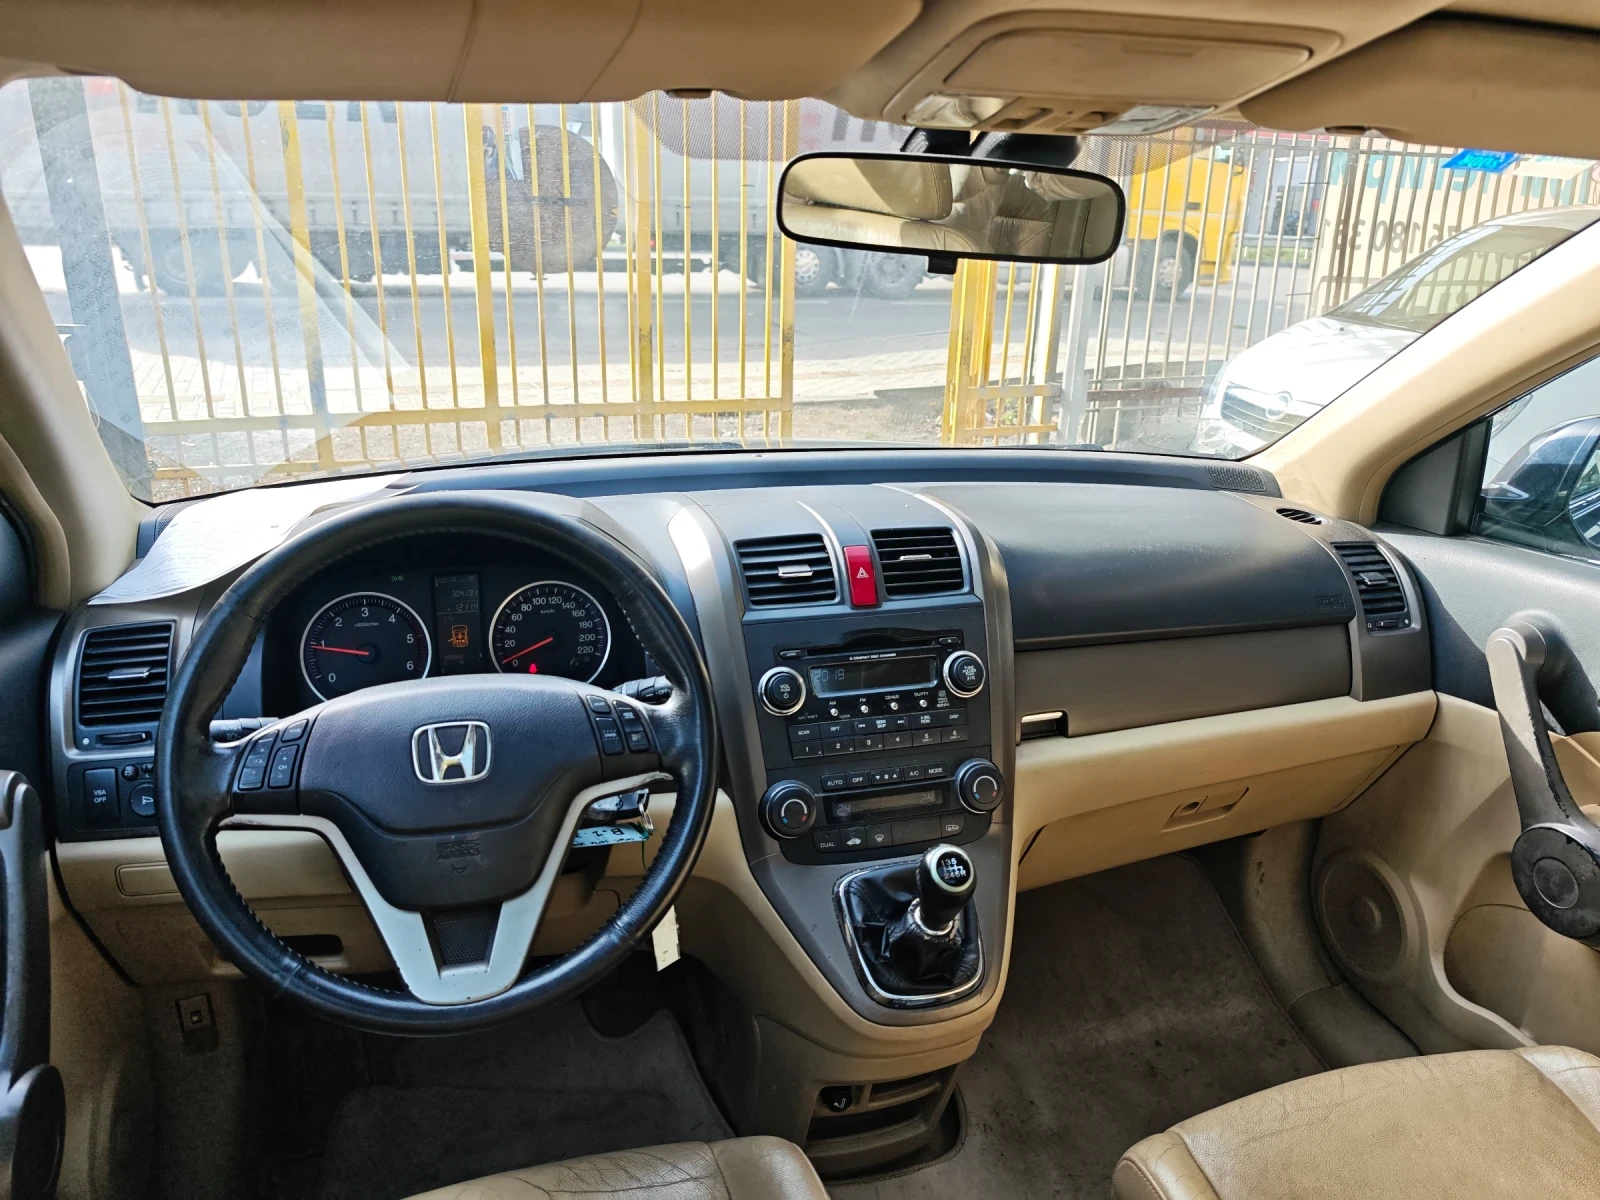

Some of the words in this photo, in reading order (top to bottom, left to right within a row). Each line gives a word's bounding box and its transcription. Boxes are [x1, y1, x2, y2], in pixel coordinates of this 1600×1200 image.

[532, 597, 546, 605] 100
[361, 607, 369, 617] 3
[572, 609, 585, 617] 160
[335, 618, 342, 626] 2
[389, 614, 396, 623] 4
[406, 634, 414, 644] 5
[579, 634, 596, 642] 200
[504, 640, 516, 648] 20
[577, 646, 594, 654] 220
[406, 661, 414, 670] 6
[328, 673, 336, 682] 0
[814, 669, 844, 682] 20:19
